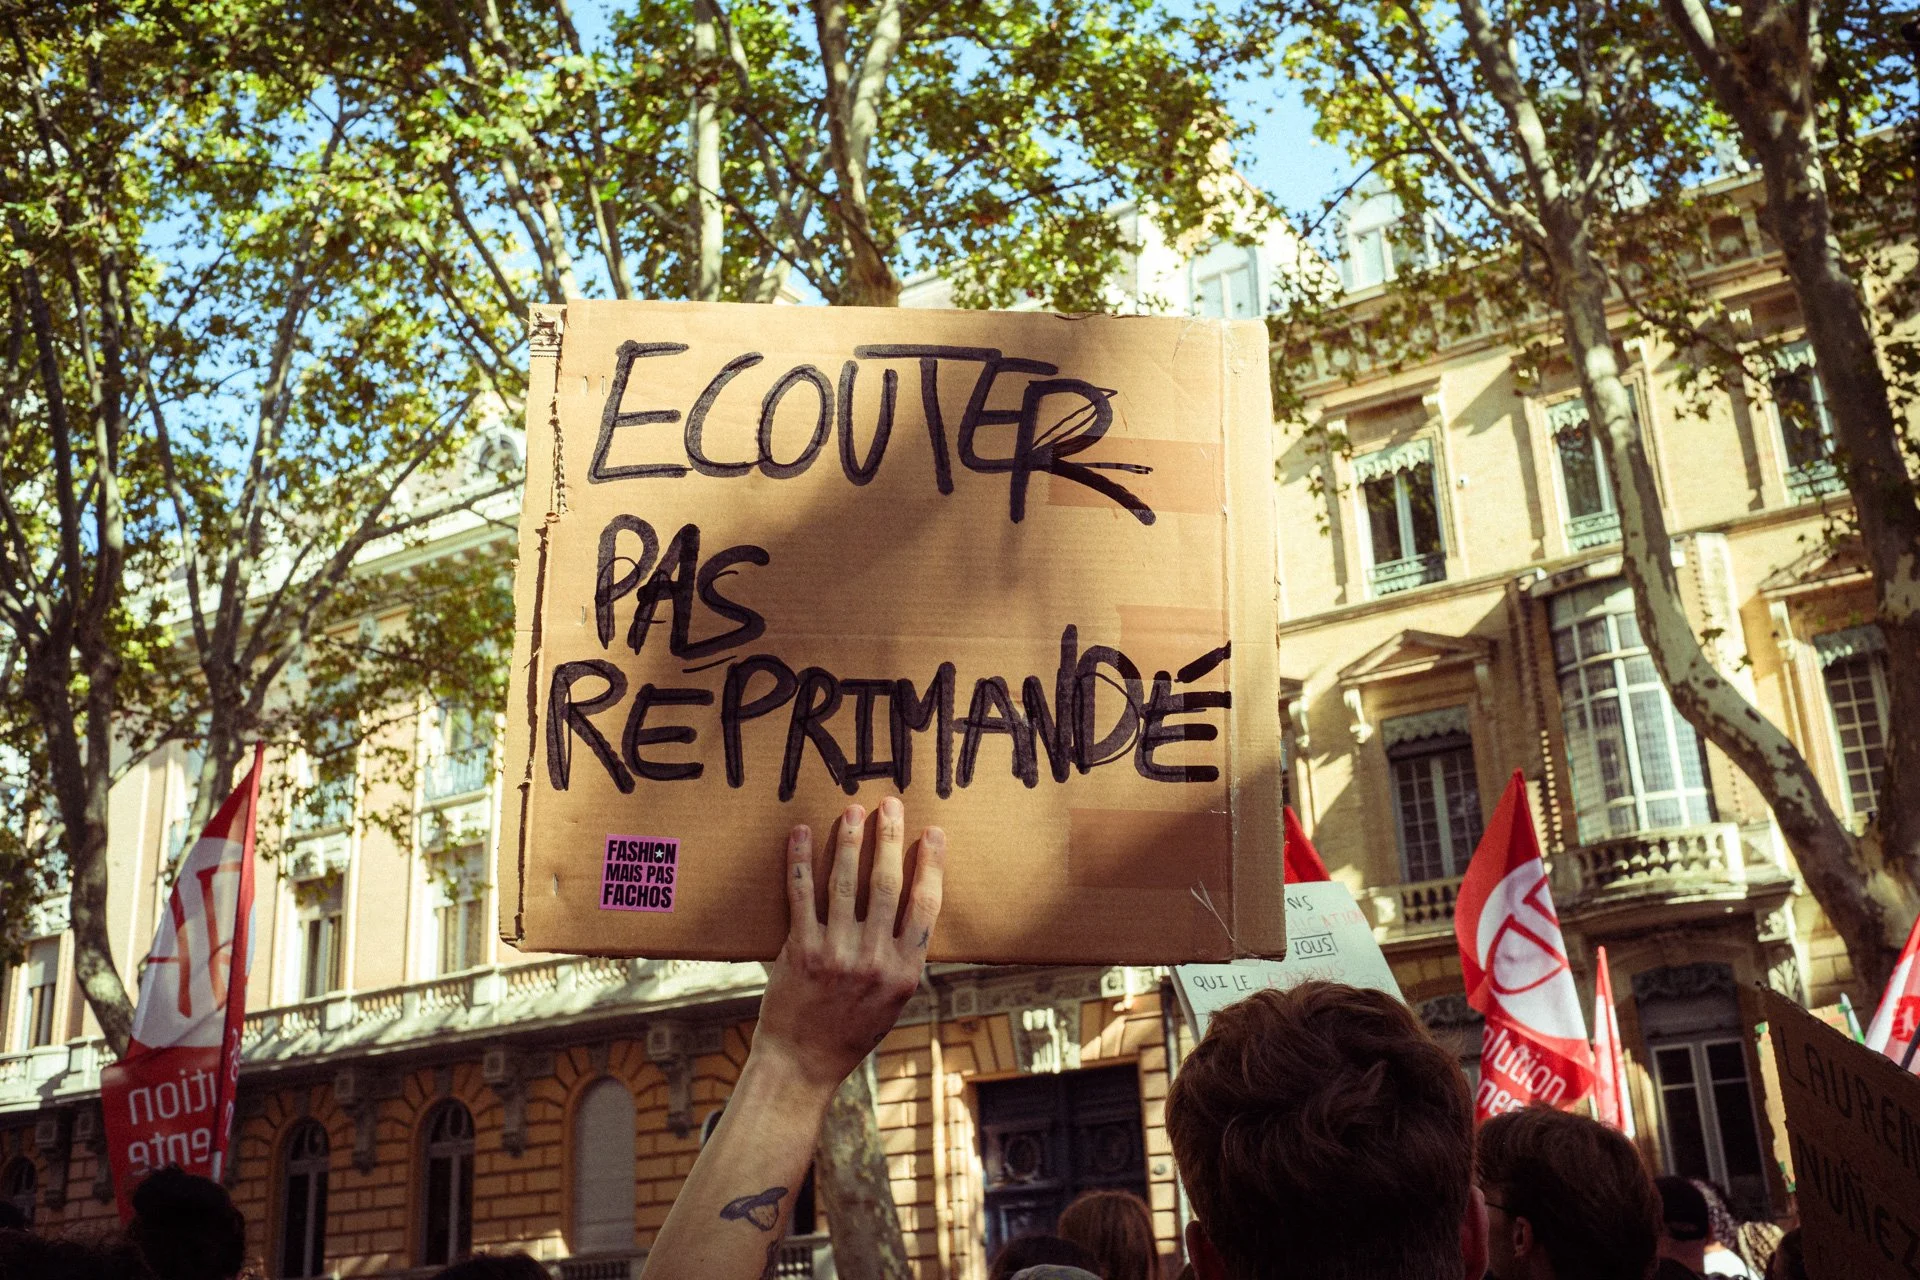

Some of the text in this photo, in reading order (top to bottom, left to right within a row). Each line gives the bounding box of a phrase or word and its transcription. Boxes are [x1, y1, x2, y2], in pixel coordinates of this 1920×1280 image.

[588, 340, 1156, 526] ECOUTER
[595, 514, 770, 660] PAS
[607, 840, 676, 864] FASHION
[605, 863, 674, 884] MAIS PAS
[603, 883, 672, 908] FACHOS
[1193, 975, 1227, 991] QUI
[1233, 974, 1252, 991] LE
